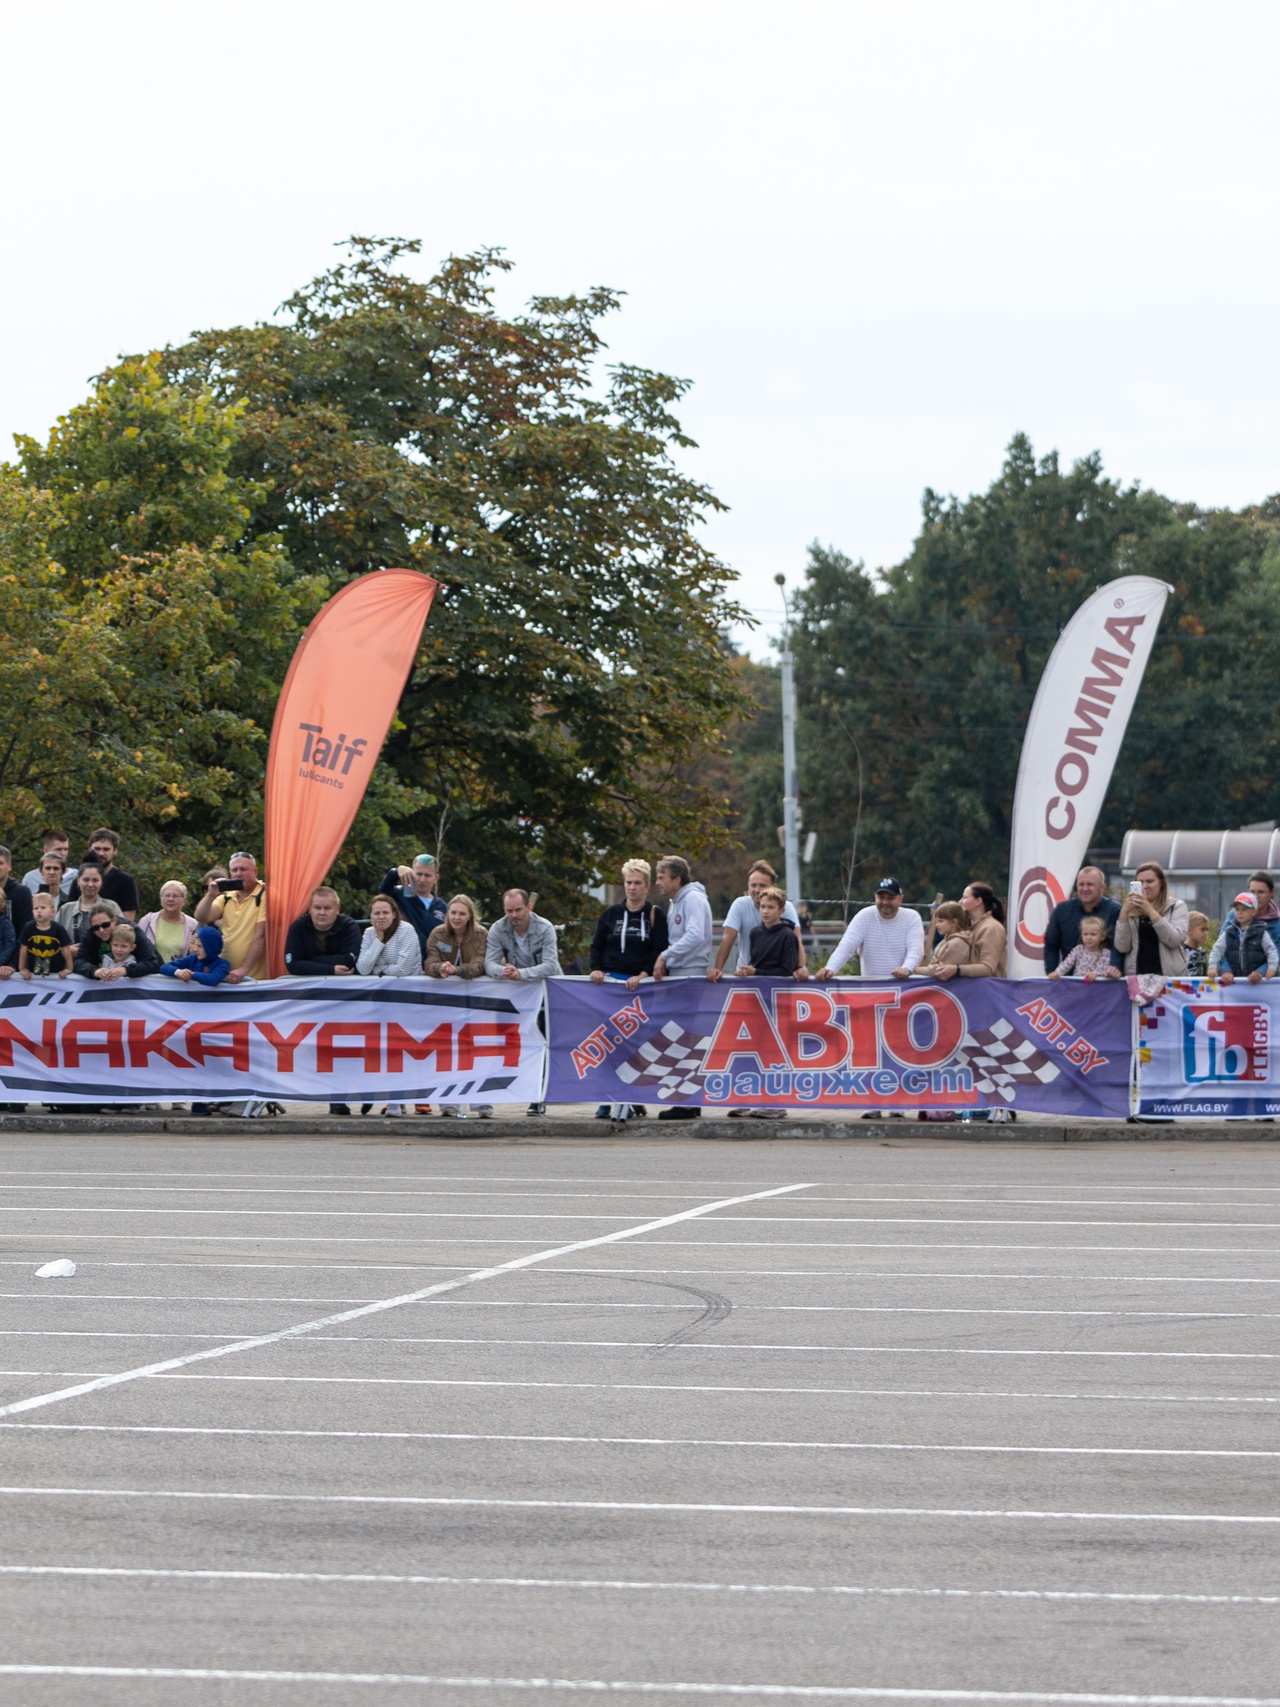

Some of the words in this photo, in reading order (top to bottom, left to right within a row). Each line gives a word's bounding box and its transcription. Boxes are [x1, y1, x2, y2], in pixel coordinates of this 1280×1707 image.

[299, 722, 368, 776] Taif
[570, 996, 650, 1080] ADT.BY
[697, 985, 968, 1073] АВТО
[1015, 997, 1109, 1075] ADT.BY
[1153, 1103, 1229, 1113] WWW.FLAG.BY
